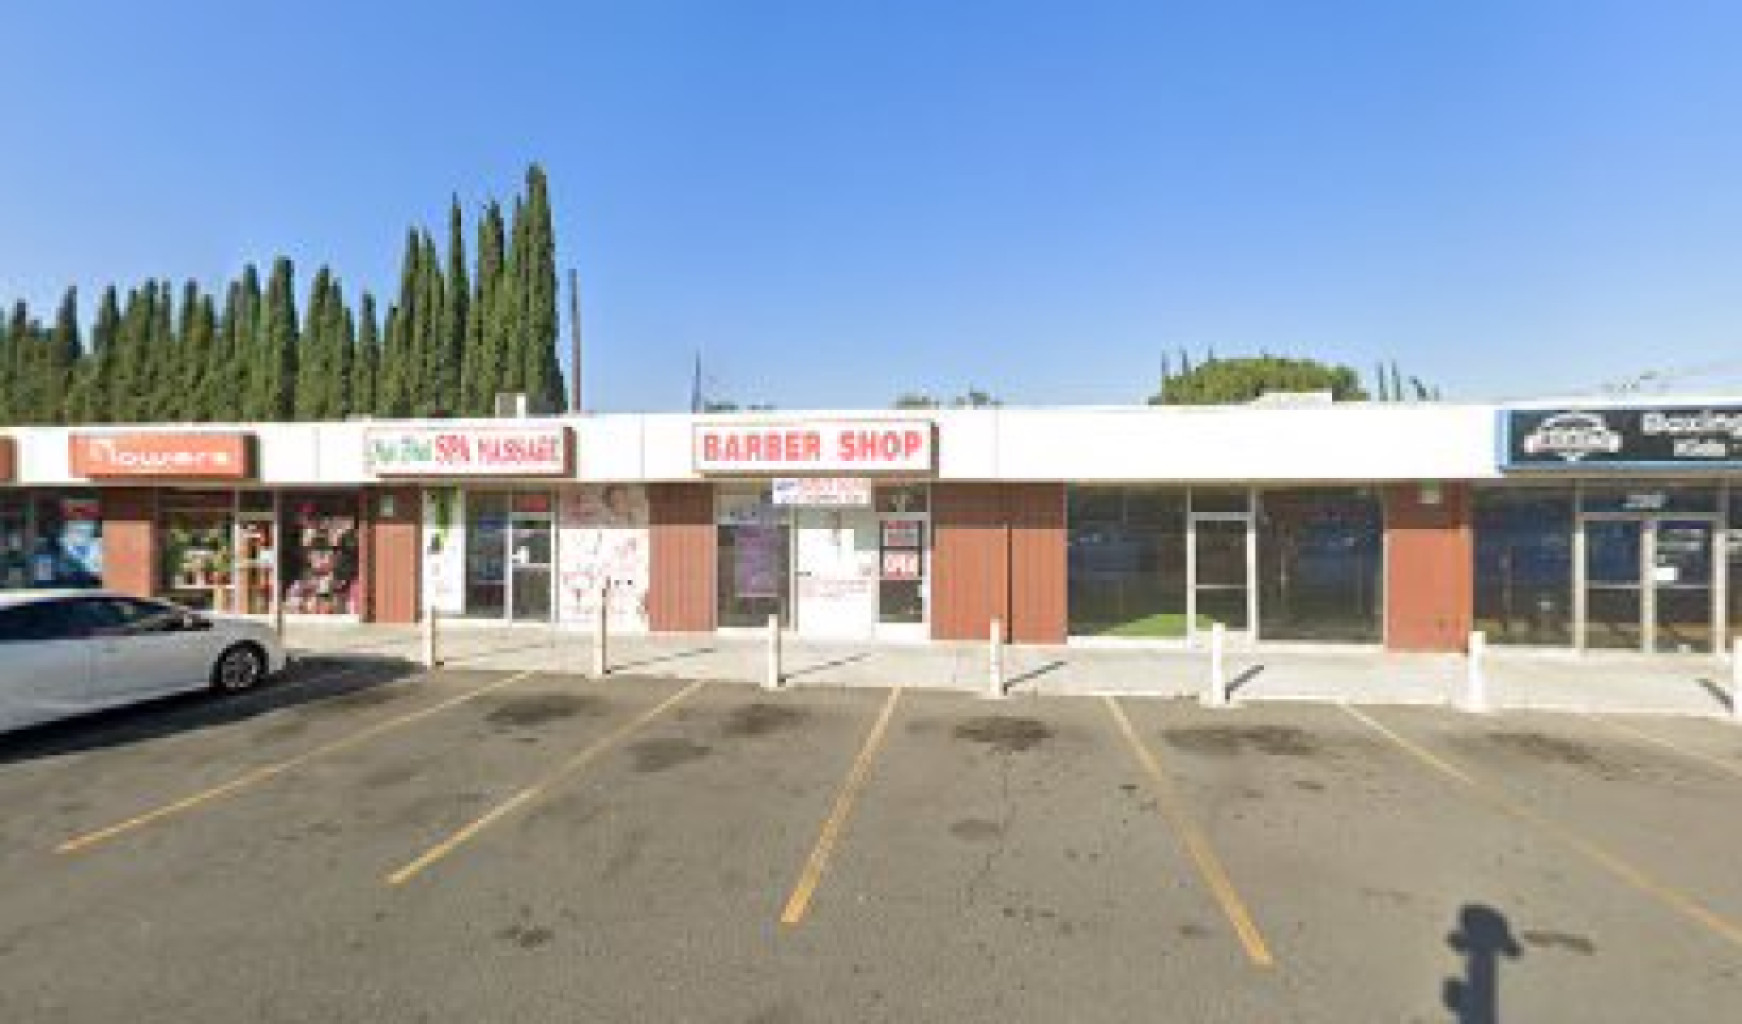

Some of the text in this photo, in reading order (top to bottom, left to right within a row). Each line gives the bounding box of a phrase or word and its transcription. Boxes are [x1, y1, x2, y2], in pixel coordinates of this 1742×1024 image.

[435, 435, 470, 463] SPA
[477, 437, 559, 462] MASSAGE
[703, 430, 922, 461] BARBER SHOP
